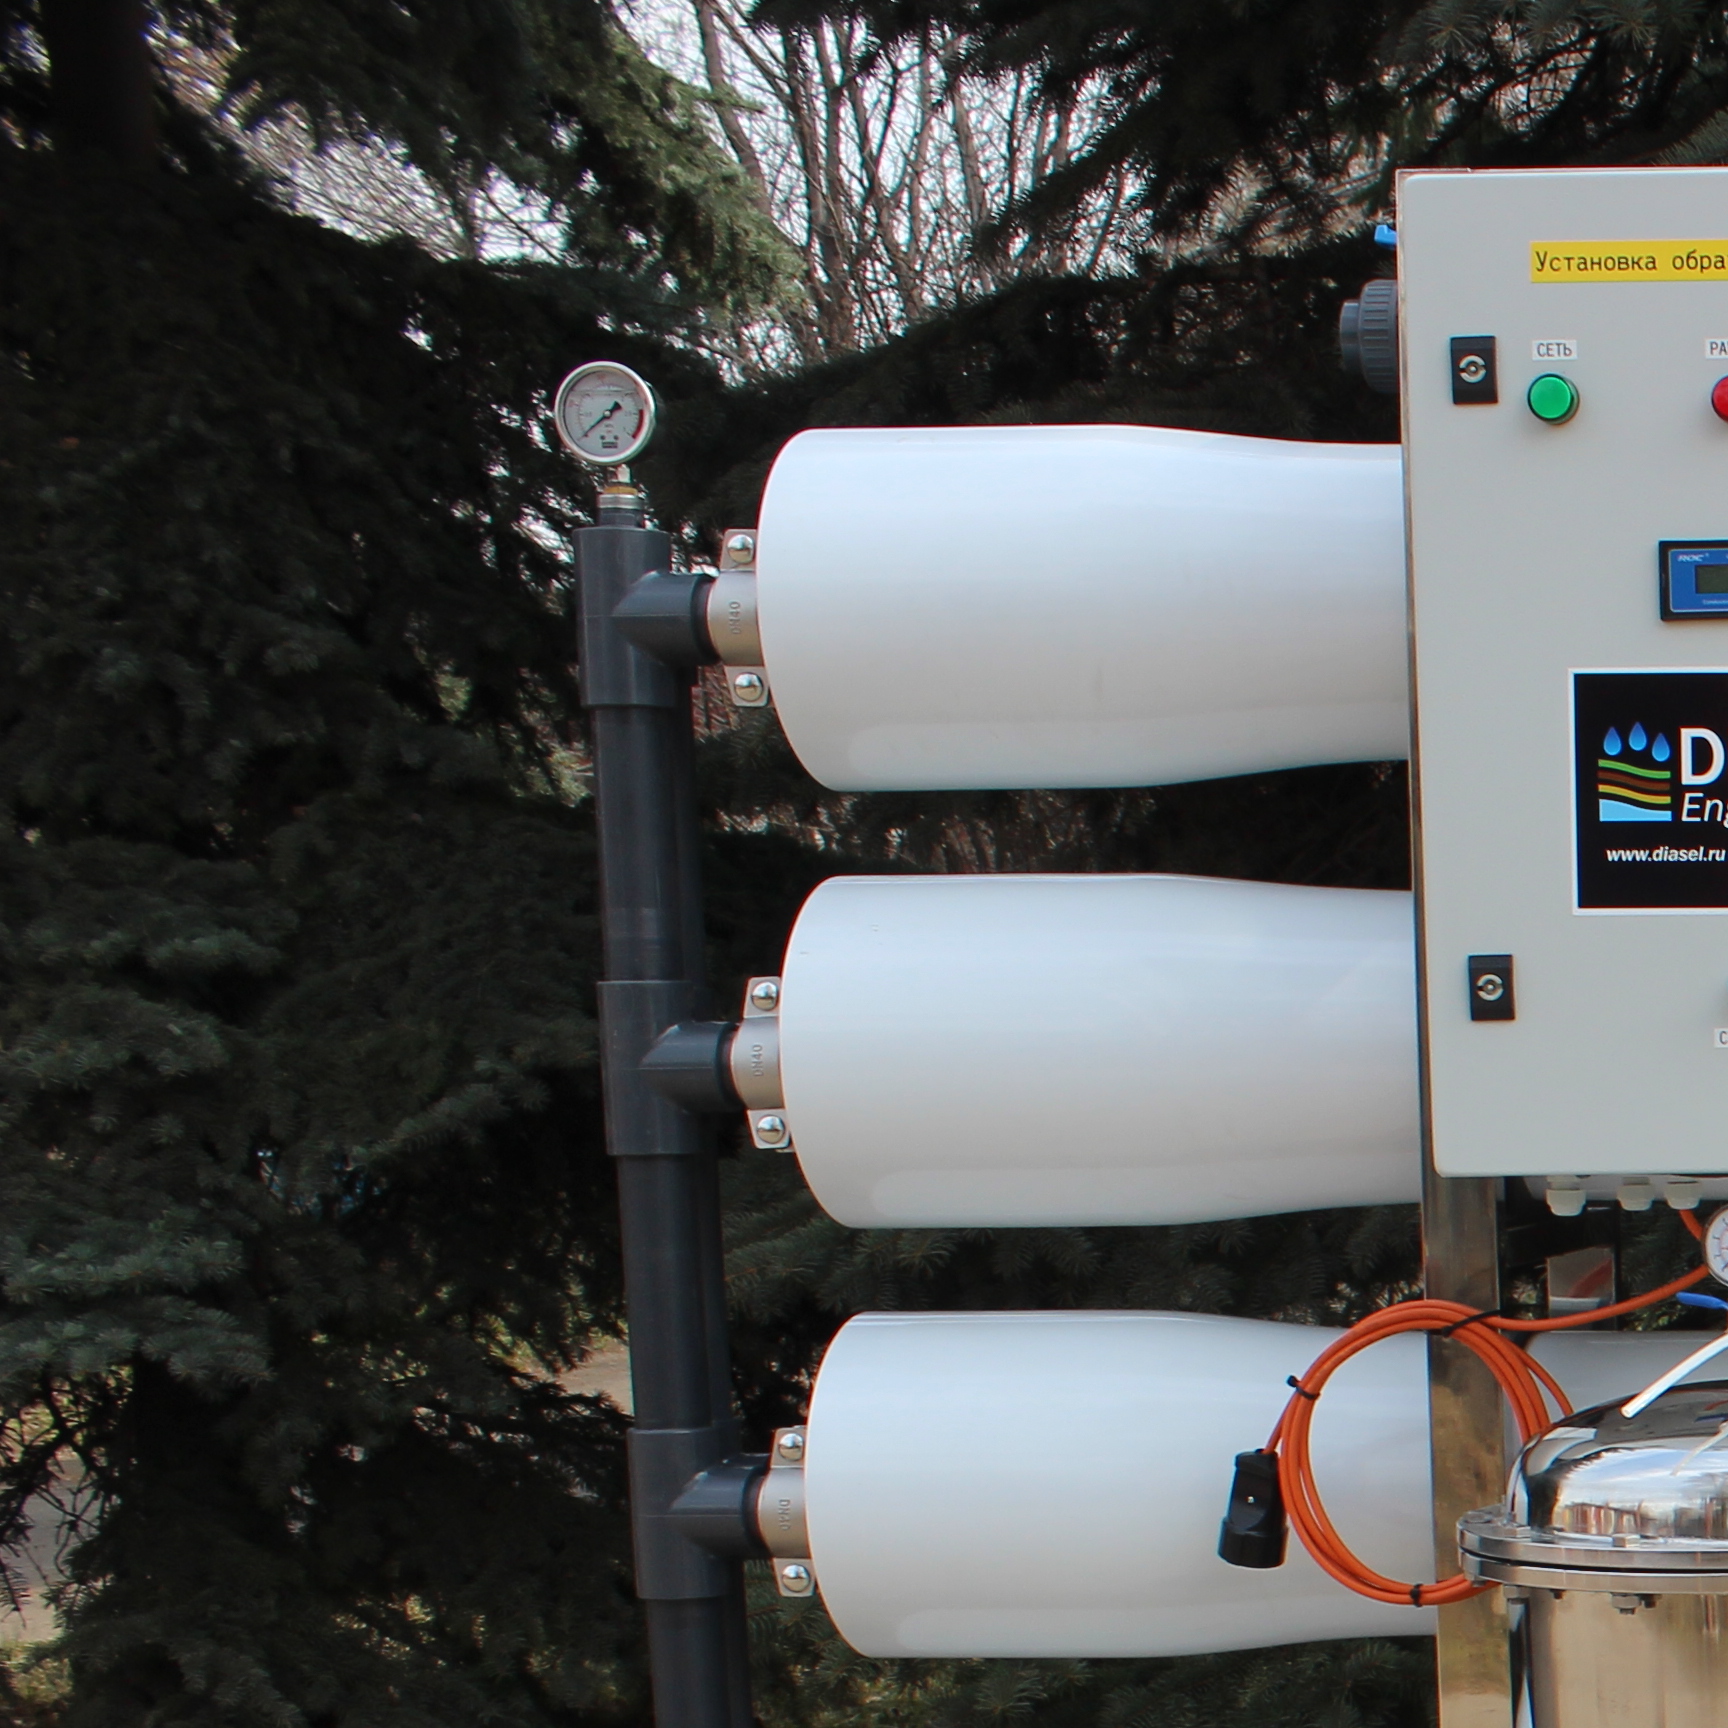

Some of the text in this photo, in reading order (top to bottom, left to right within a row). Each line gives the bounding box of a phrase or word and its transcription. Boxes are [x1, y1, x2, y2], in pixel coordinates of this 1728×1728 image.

[1536, 250, 1657, 275] Установка
[1537, 342, 1573, 358] СЕТЬ
[1606, 846, 1726, 864] www.diasel.ru
